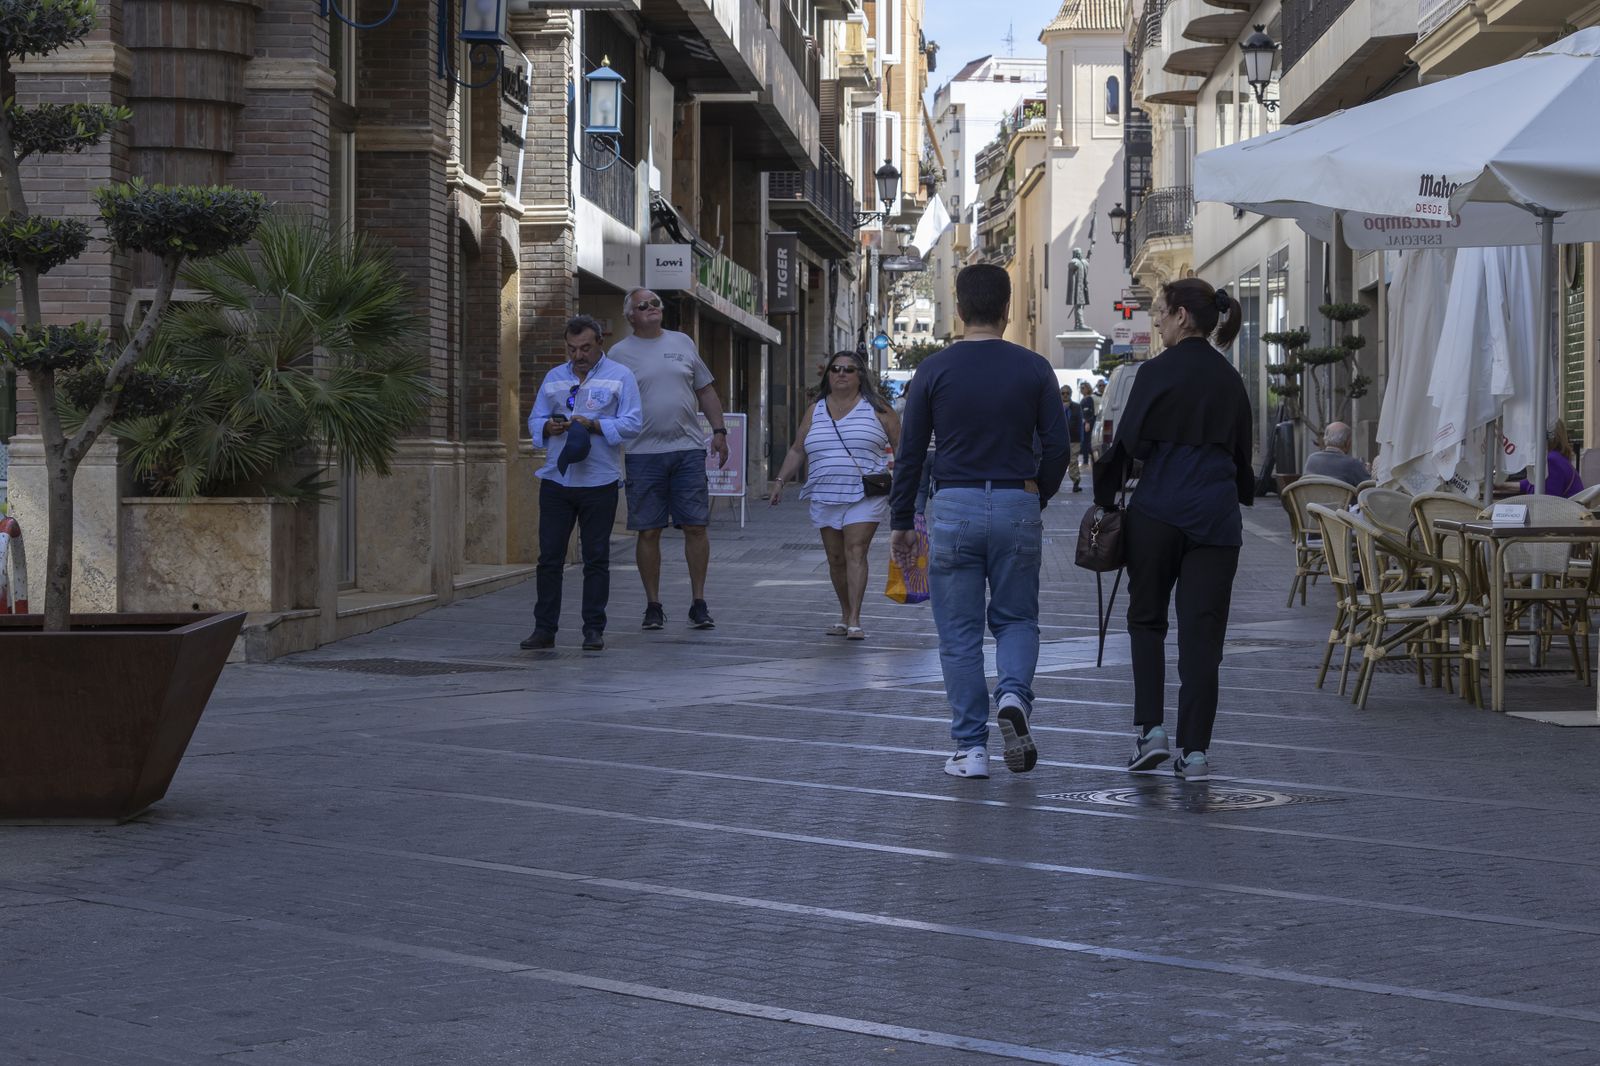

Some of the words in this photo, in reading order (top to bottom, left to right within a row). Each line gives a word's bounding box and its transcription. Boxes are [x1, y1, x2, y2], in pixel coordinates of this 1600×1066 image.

[1418, 174, 1462, 199] Maho
[1415, 203, 1443, 215] DESDE
[655, 257, 683, 267] Lowi
[777, 248, 788, 298] TIGER
